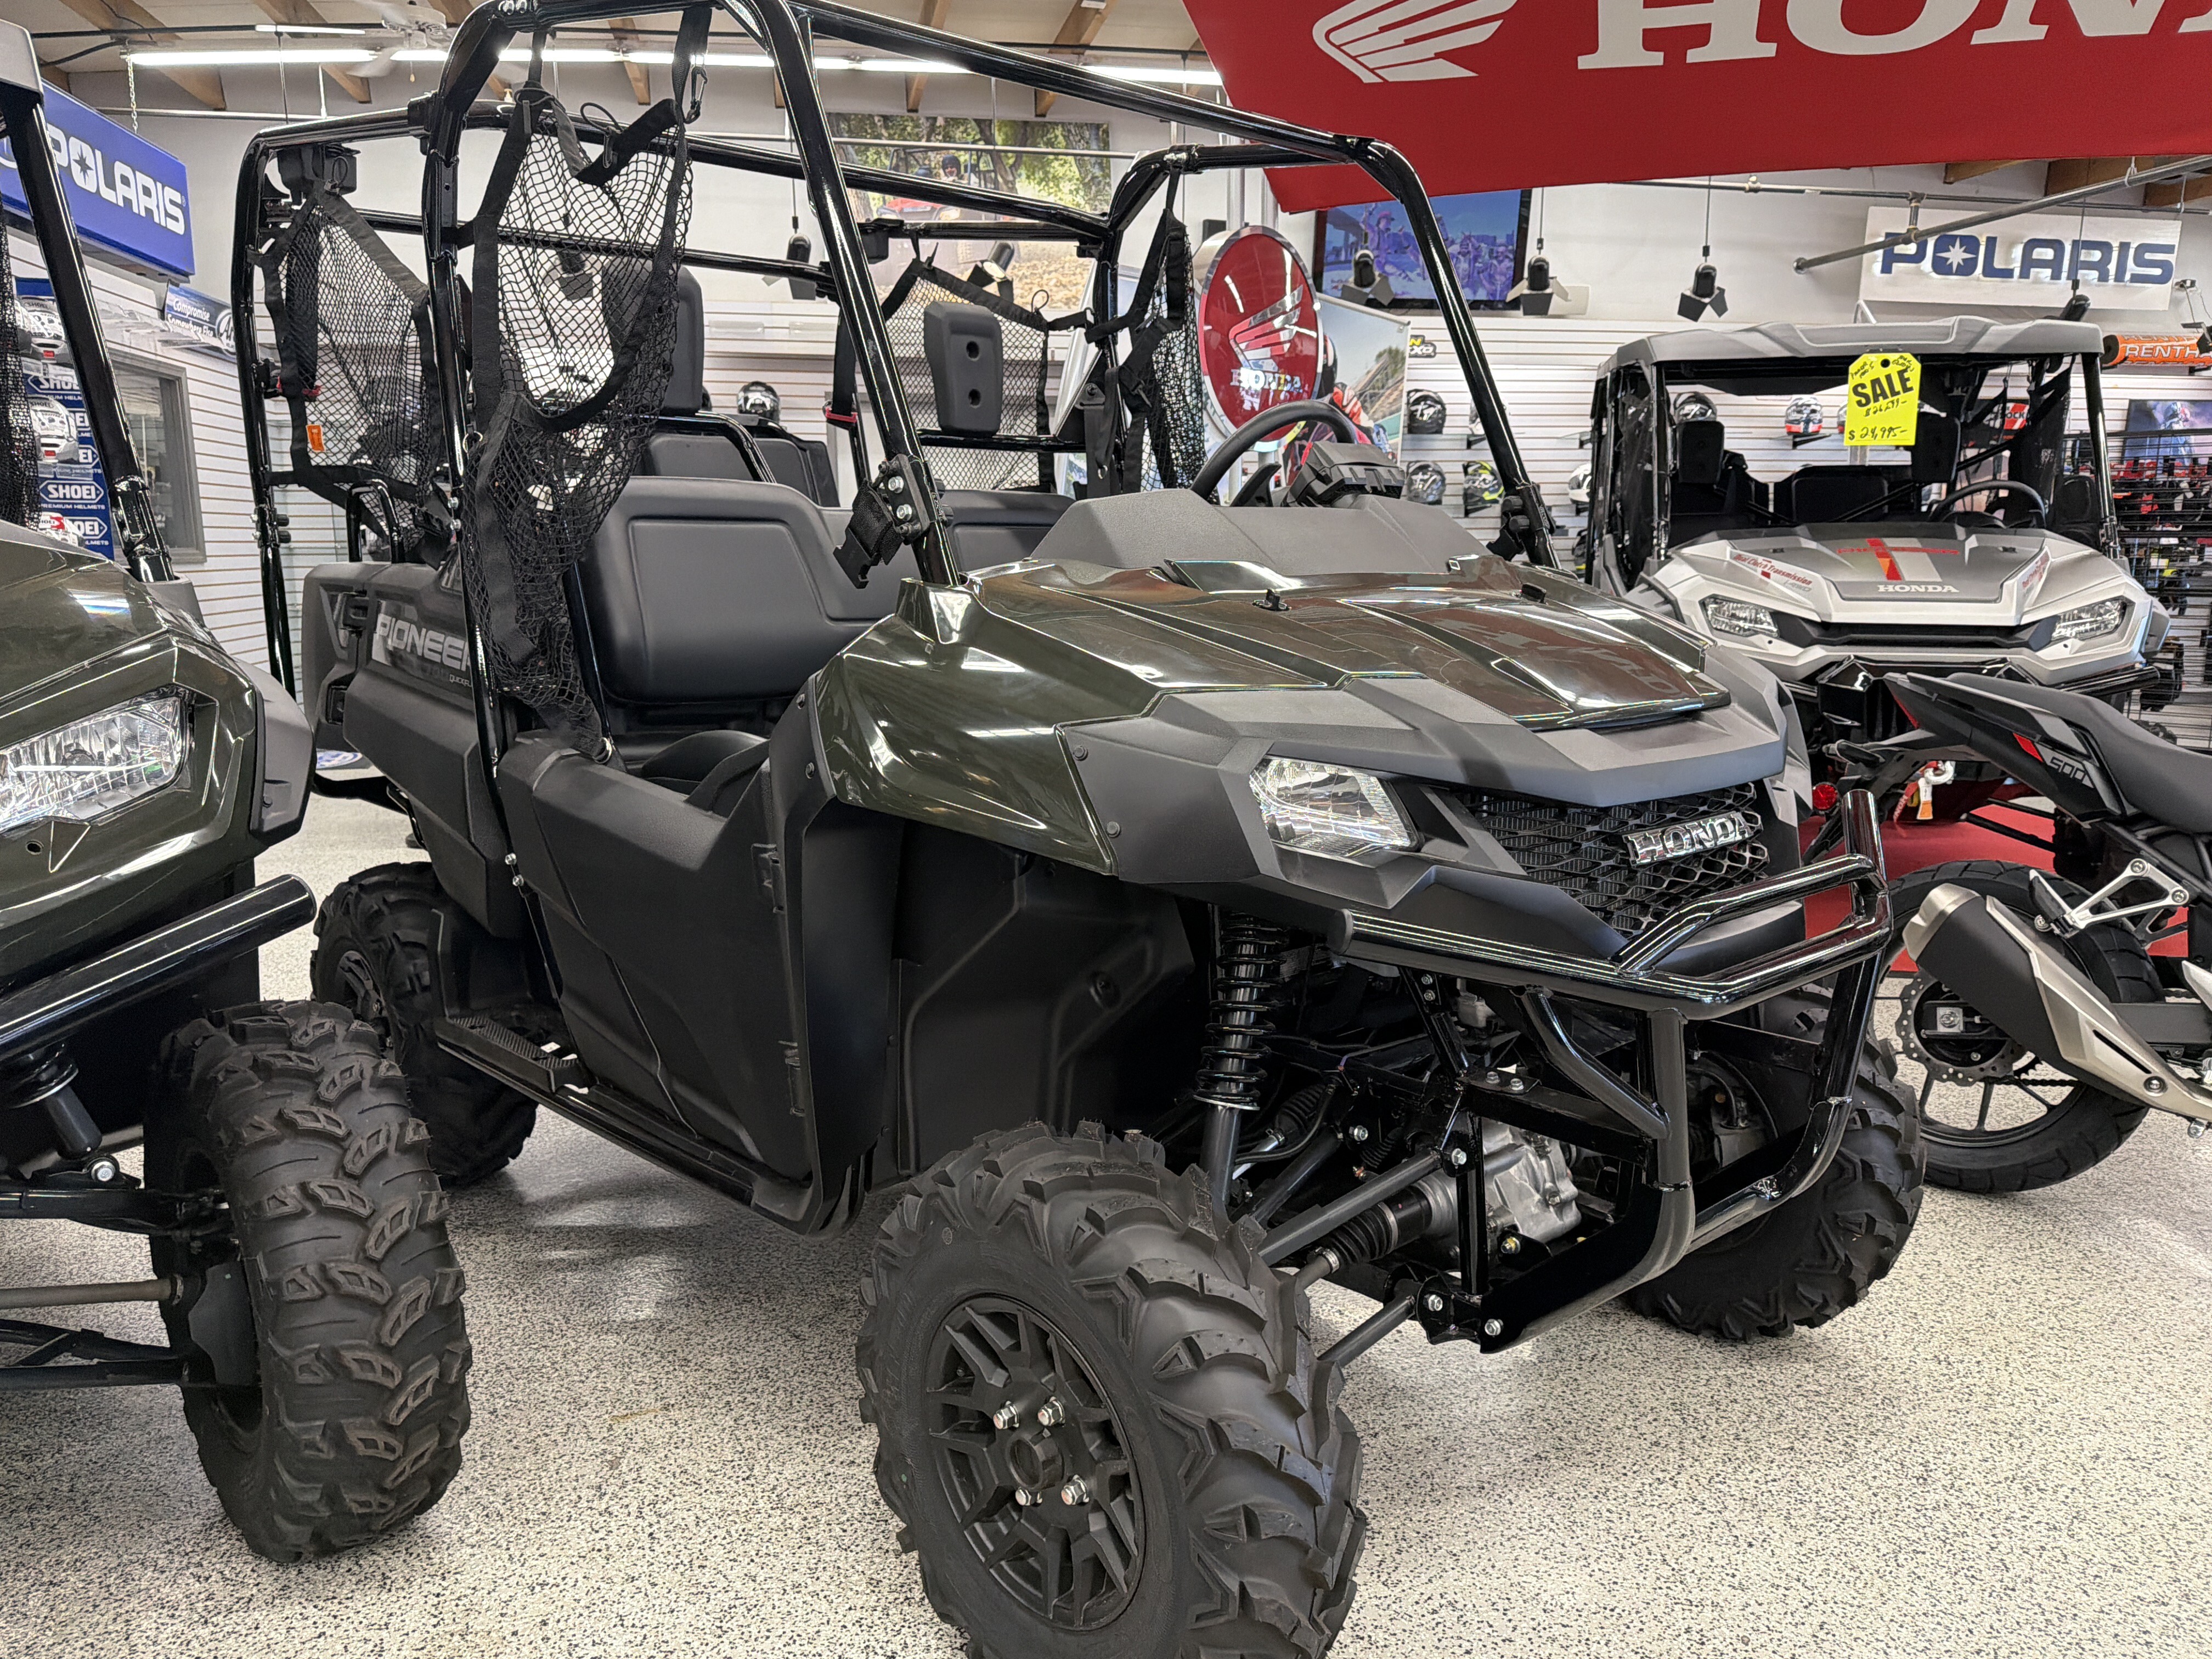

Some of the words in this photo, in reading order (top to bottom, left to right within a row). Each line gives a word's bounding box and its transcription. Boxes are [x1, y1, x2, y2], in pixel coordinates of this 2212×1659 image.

[46, 122, 185, 235] POLARIS
[1880, 232, 2176, 285] POLARIS
[173, 298, 210, 321] Compromise
[40, 374, 80, 390] SHOE
[1229, 367, 1303, 393] HONDA
[1852, 368, 1914, 408] SALE
[47, 484, 96, 499] SHOEI
[74, 521, 99, 535] OEI
[1734, 554, 1748, 562] Dual
[1747, 558, 1768, 569] Clutch
[1768, 565, 1813, 585] Transmission
[1877, 584, 1960, 593] HONDA
[1623, 812, 1754, 867] HONDA
